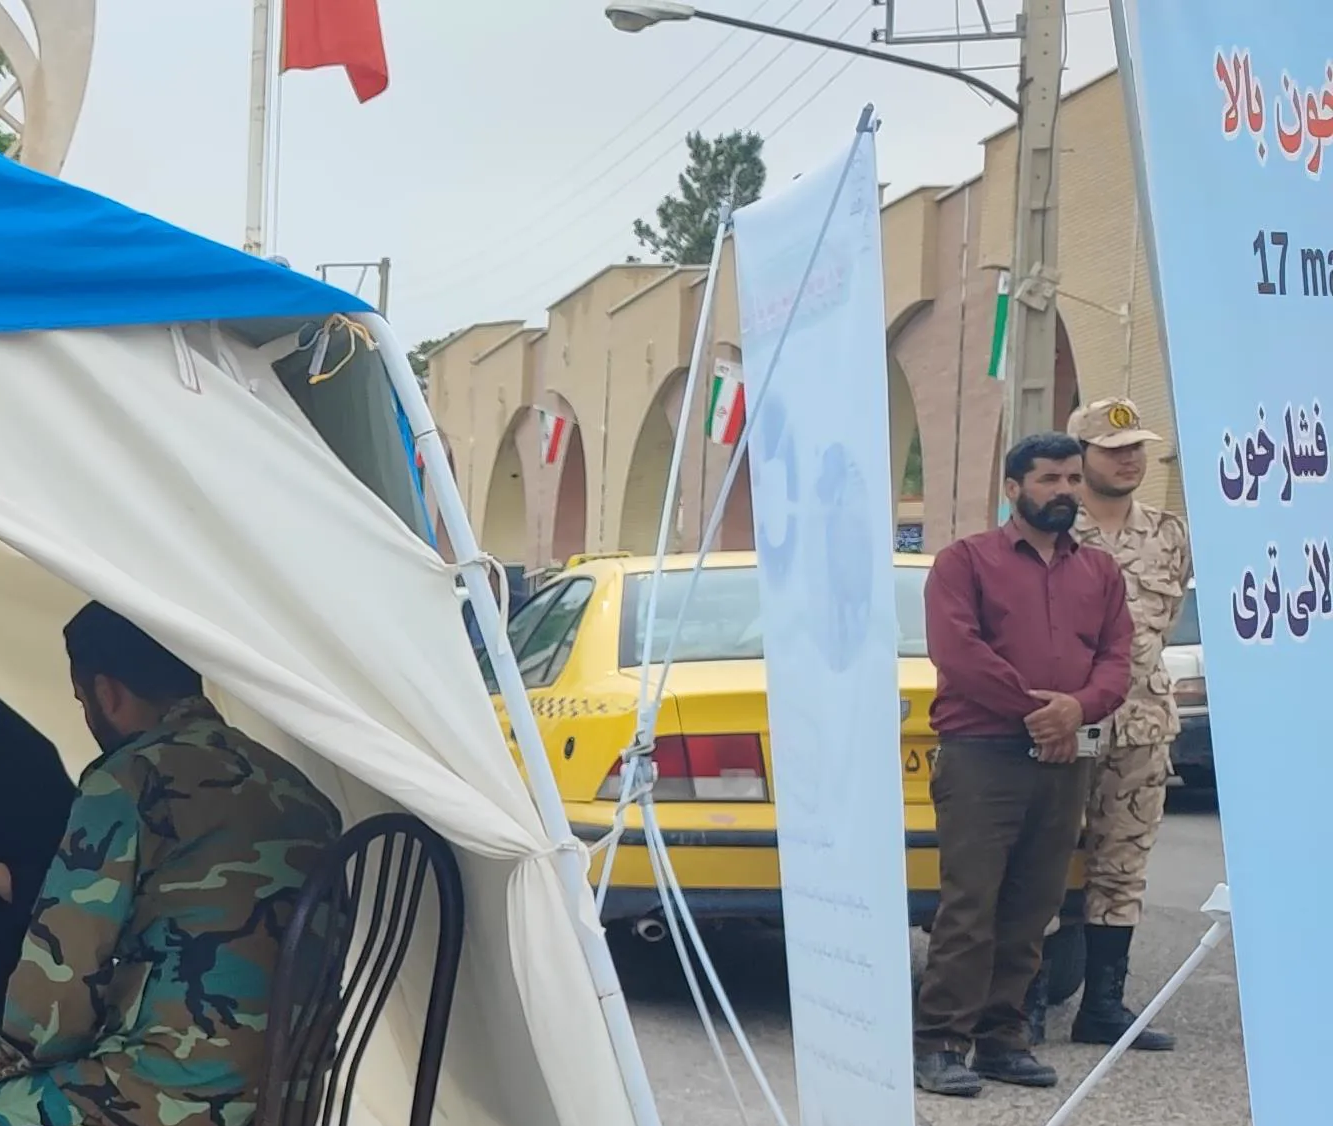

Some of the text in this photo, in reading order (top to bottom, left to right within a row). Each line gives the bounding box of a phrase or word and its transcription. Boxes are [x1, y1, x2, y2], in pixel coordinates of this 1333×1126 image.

[1216, 51, 1265, 161] بالا
[1252, 229, 1289, 296] 17
[1219, 402, 1329, 502] فشار خون
[1232, 540, 1333, 640] لانی تری
